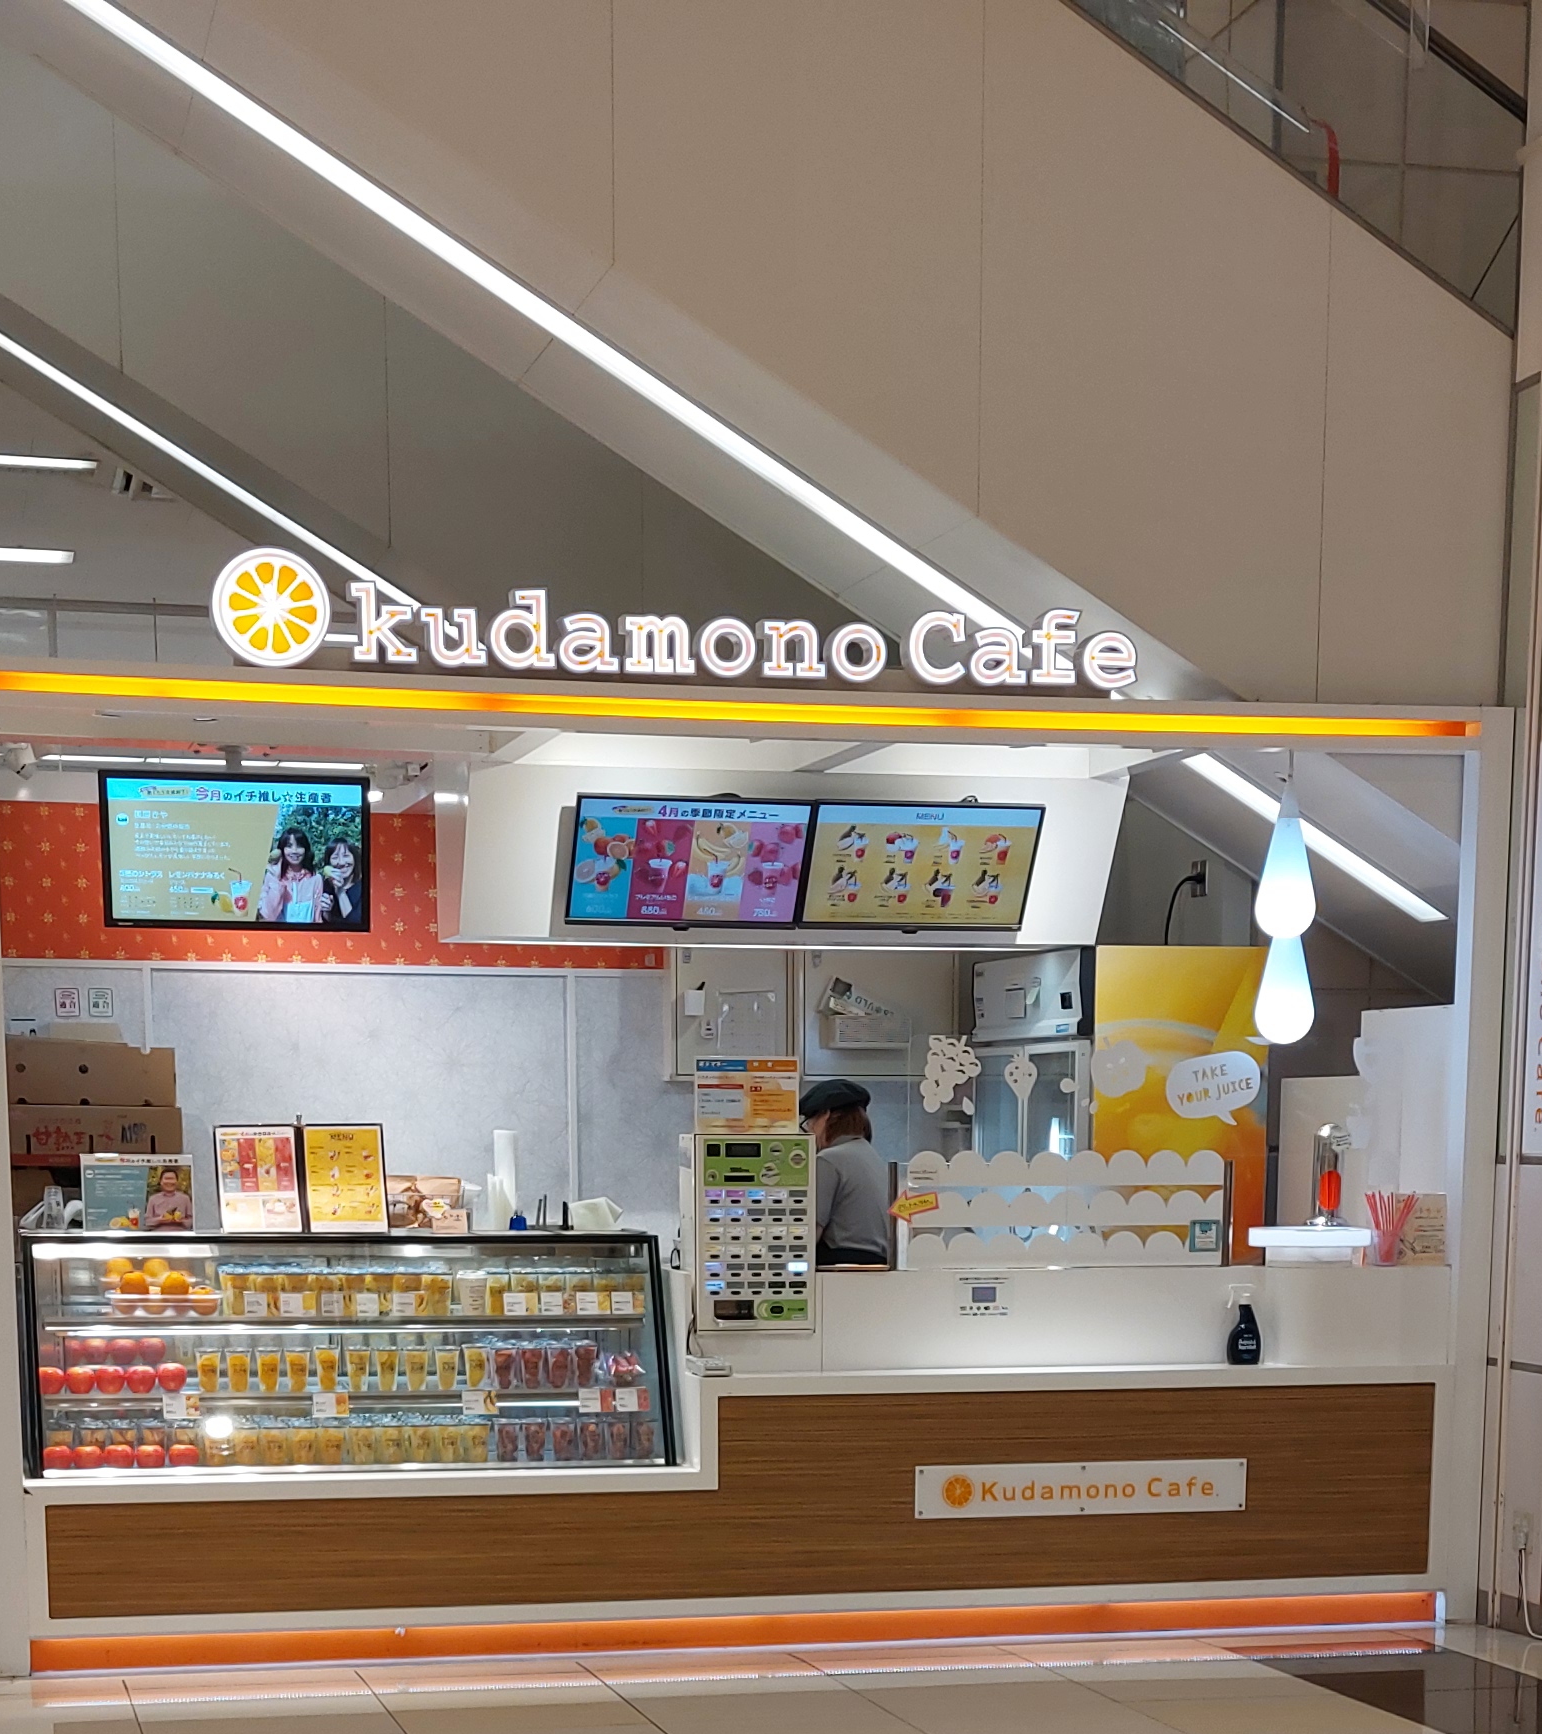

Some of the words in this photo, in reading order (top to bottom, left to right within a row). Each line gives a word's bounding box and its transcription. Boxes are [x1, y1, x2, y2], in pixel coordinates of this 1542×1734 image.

[349, 581, 889, 683] kudamono
[907, 609, 1139, 689] Cafe
[915, 812, 945, 821] MENU
[1192, 1063, 1229, 1083] TAKE
[1177, 1087, 1211, 1107] YOUR
[1216, 1077, 1254, 1101] JUICE
[981, 1480, 1136, 1502] Kudamono
[1147, 1476, 1214, 1498] Cafe
